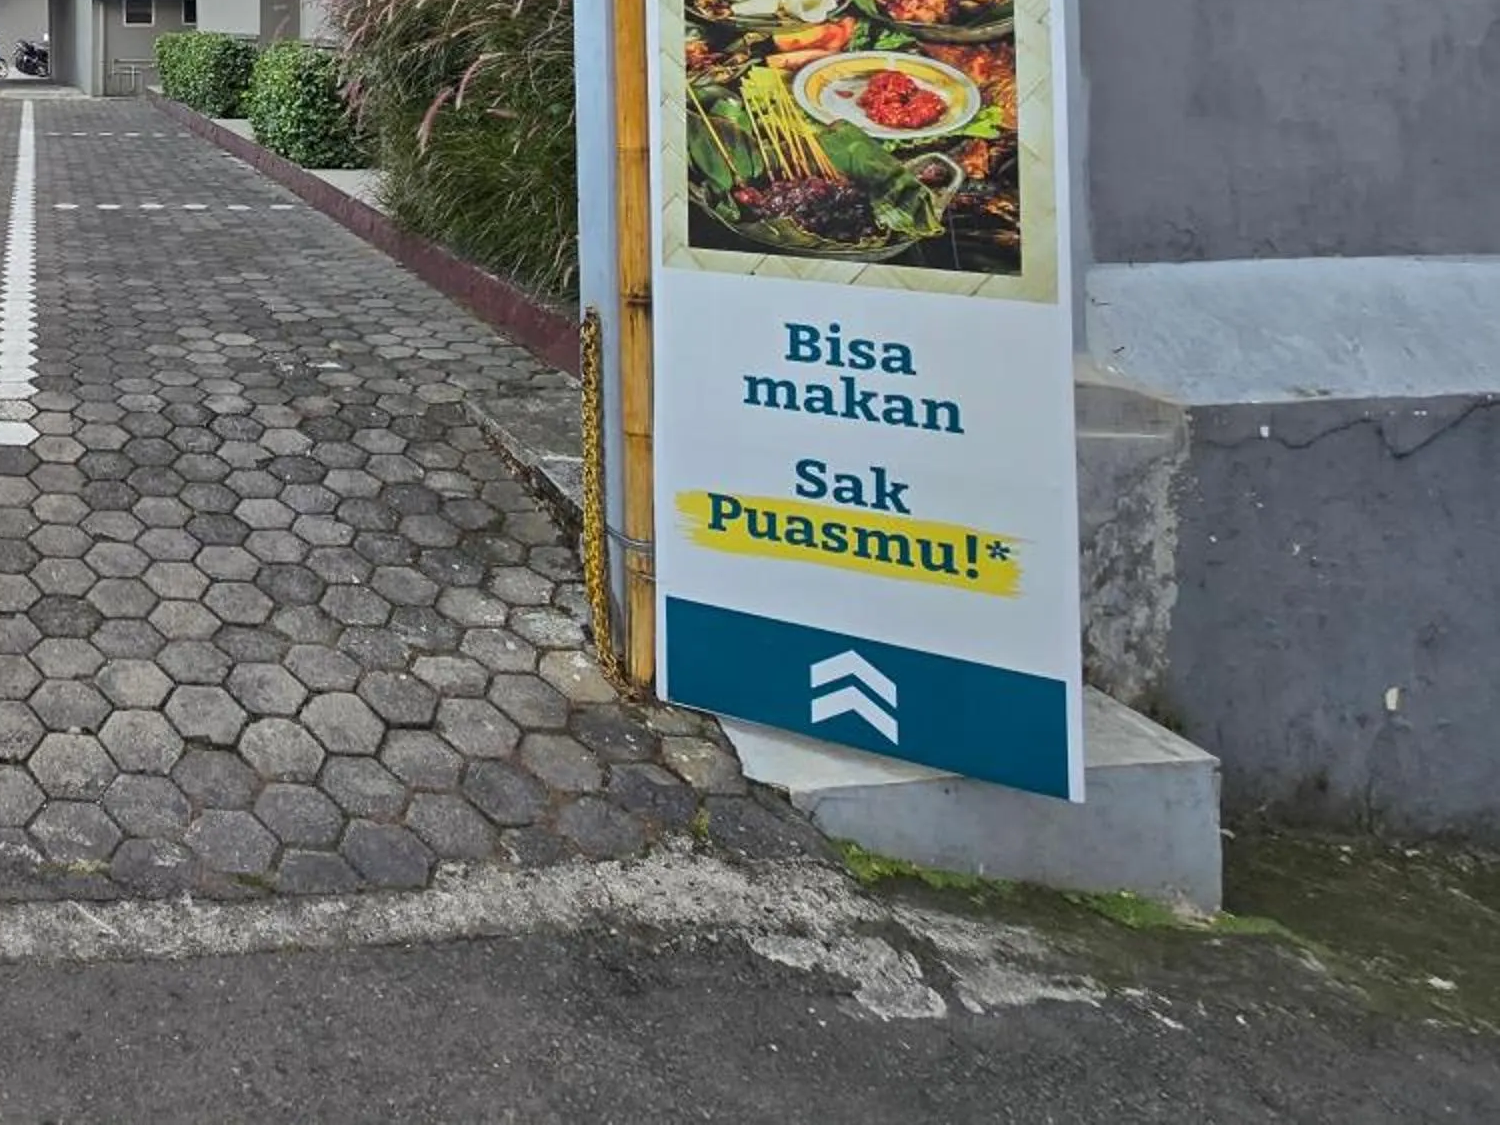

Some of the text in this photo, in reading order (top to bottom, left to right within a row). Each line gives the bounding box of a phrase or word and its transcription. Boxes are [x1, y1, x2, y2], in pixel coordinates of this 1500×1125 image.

[785, 322, 917, 376] Bisa
[743, 375, 965, 434] makan
[795, 458, 911, 515] Sak
